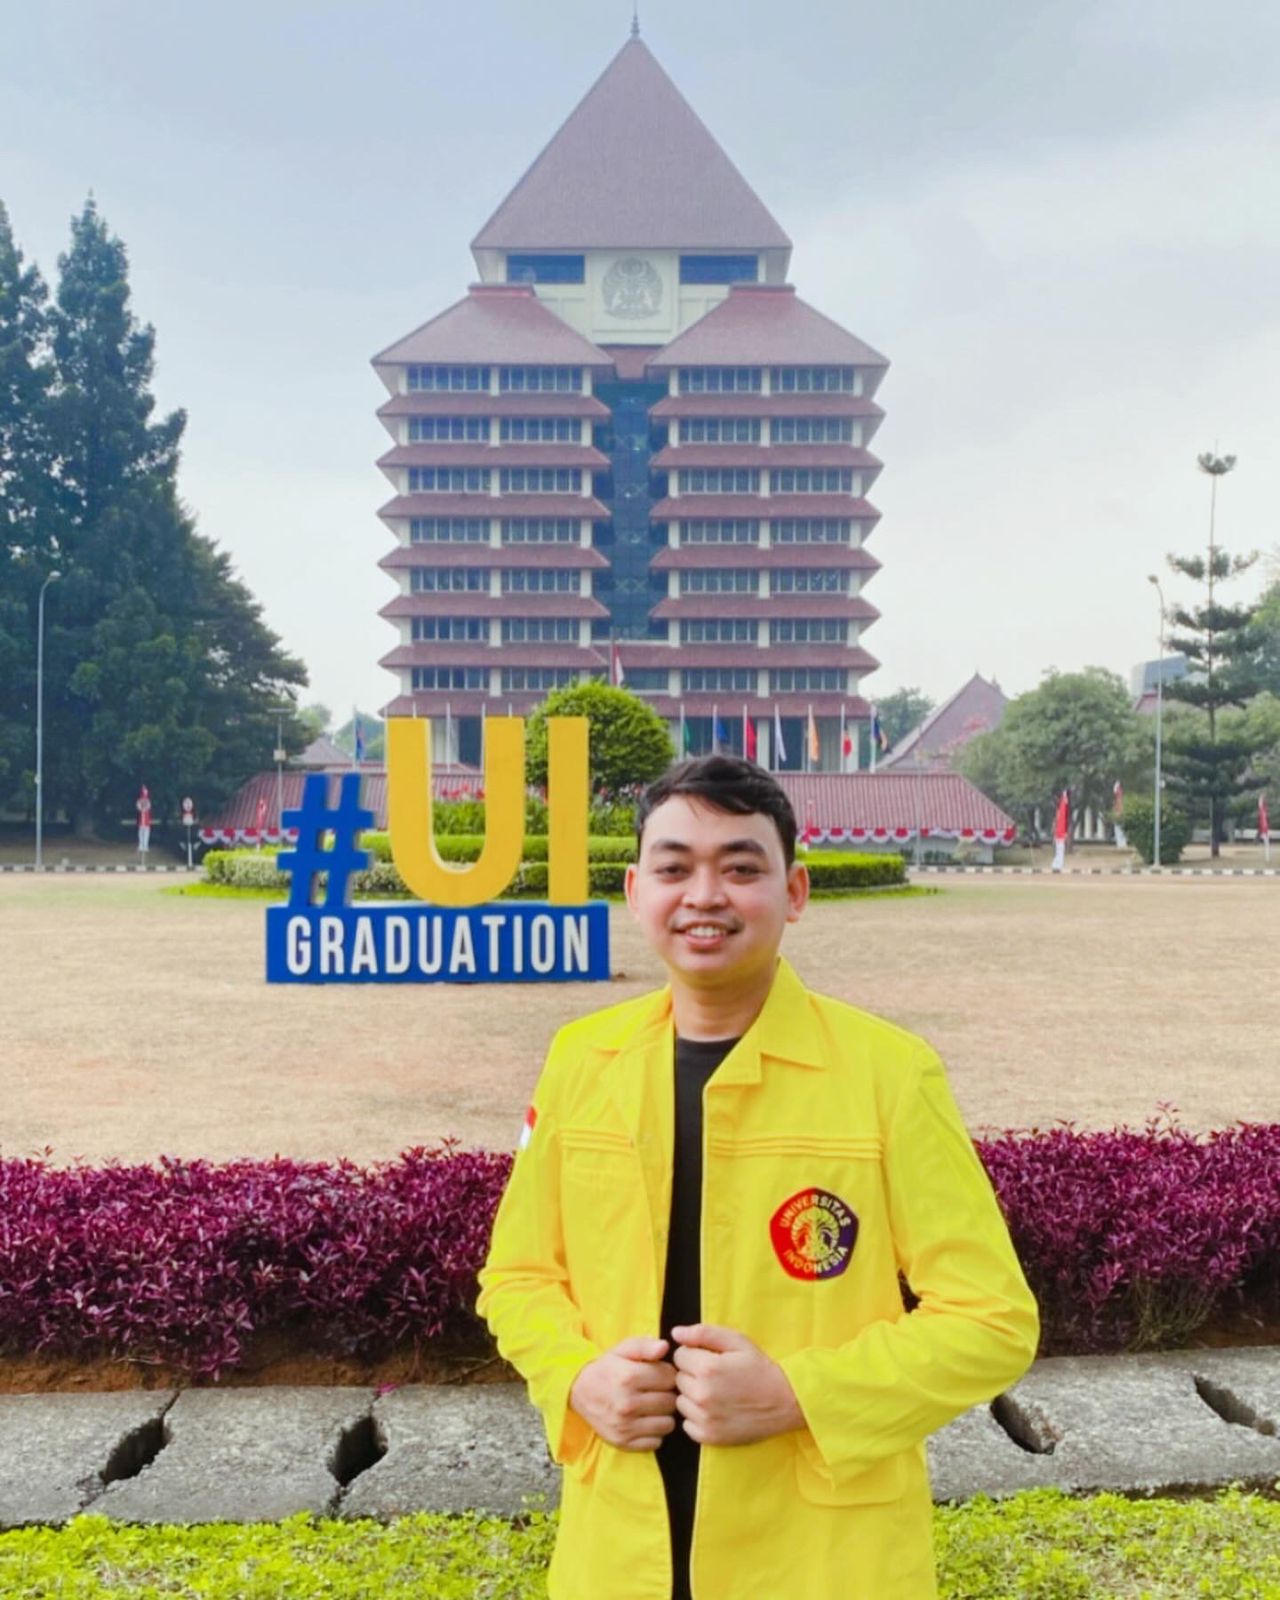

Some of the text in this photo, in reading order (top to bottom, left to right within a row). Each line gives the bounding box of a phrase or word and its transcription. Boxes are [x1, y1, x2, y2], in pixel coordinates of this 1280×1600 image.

[287, 914, 589, 975] GRADUATION
[780, 1194, 851, 1227] UNIVERSITAS
[784, 1247, 848, 1273] INDONESIA
